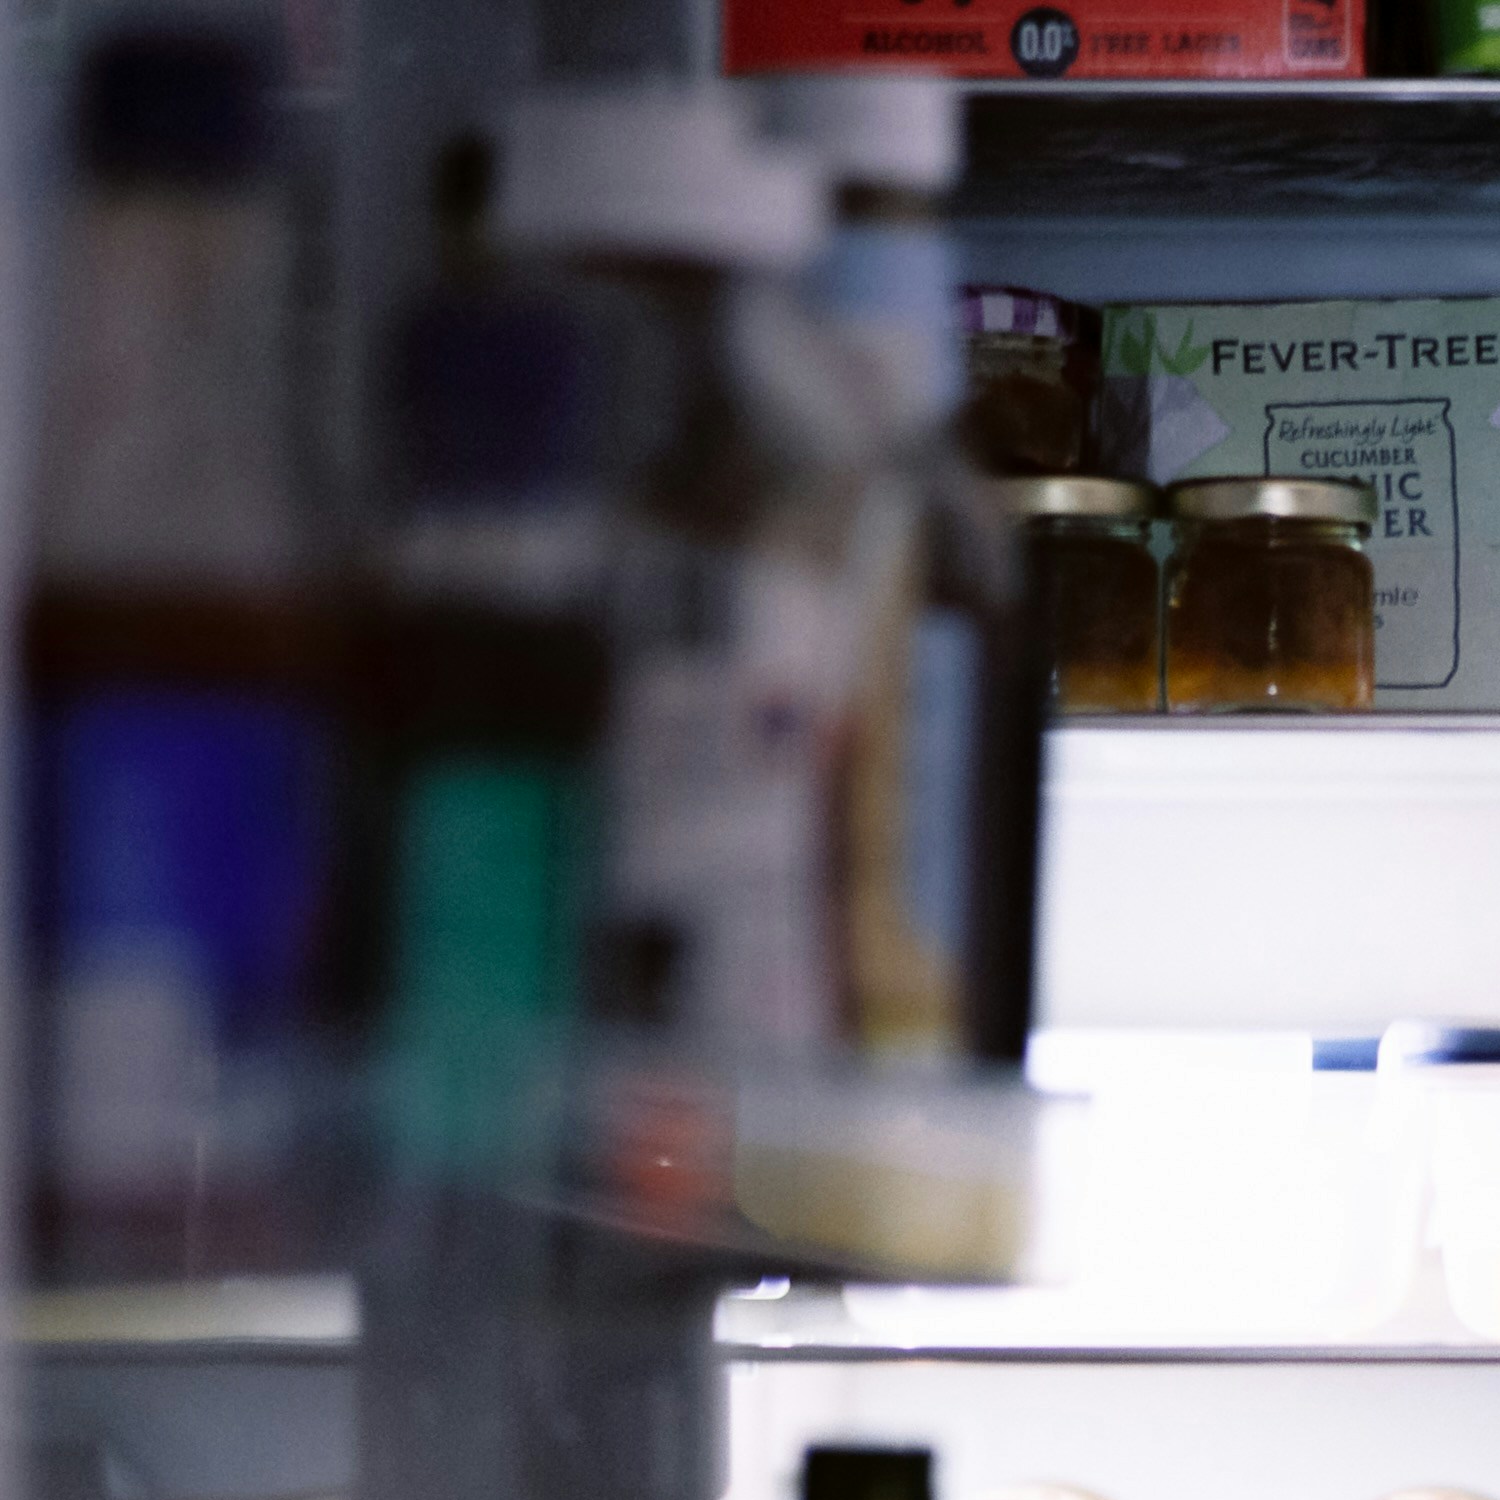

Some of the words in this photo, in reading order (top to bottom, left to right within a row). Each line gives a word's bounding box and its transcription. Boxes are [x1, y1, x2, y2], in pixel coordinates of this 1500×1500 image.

[863, 31, 987, 54] ALCOHOL
[1091, 33, 1151, 54] FREE
[1212, 332, 1499, 376] FEVER-TREE
[1279, 414, 1386, 447] Refreshingly
[1390, 412, 1436, 443] Light
[1300, 447, 1416, 468] CUCUMBER
[1383, 508, 1433, 539] ER
